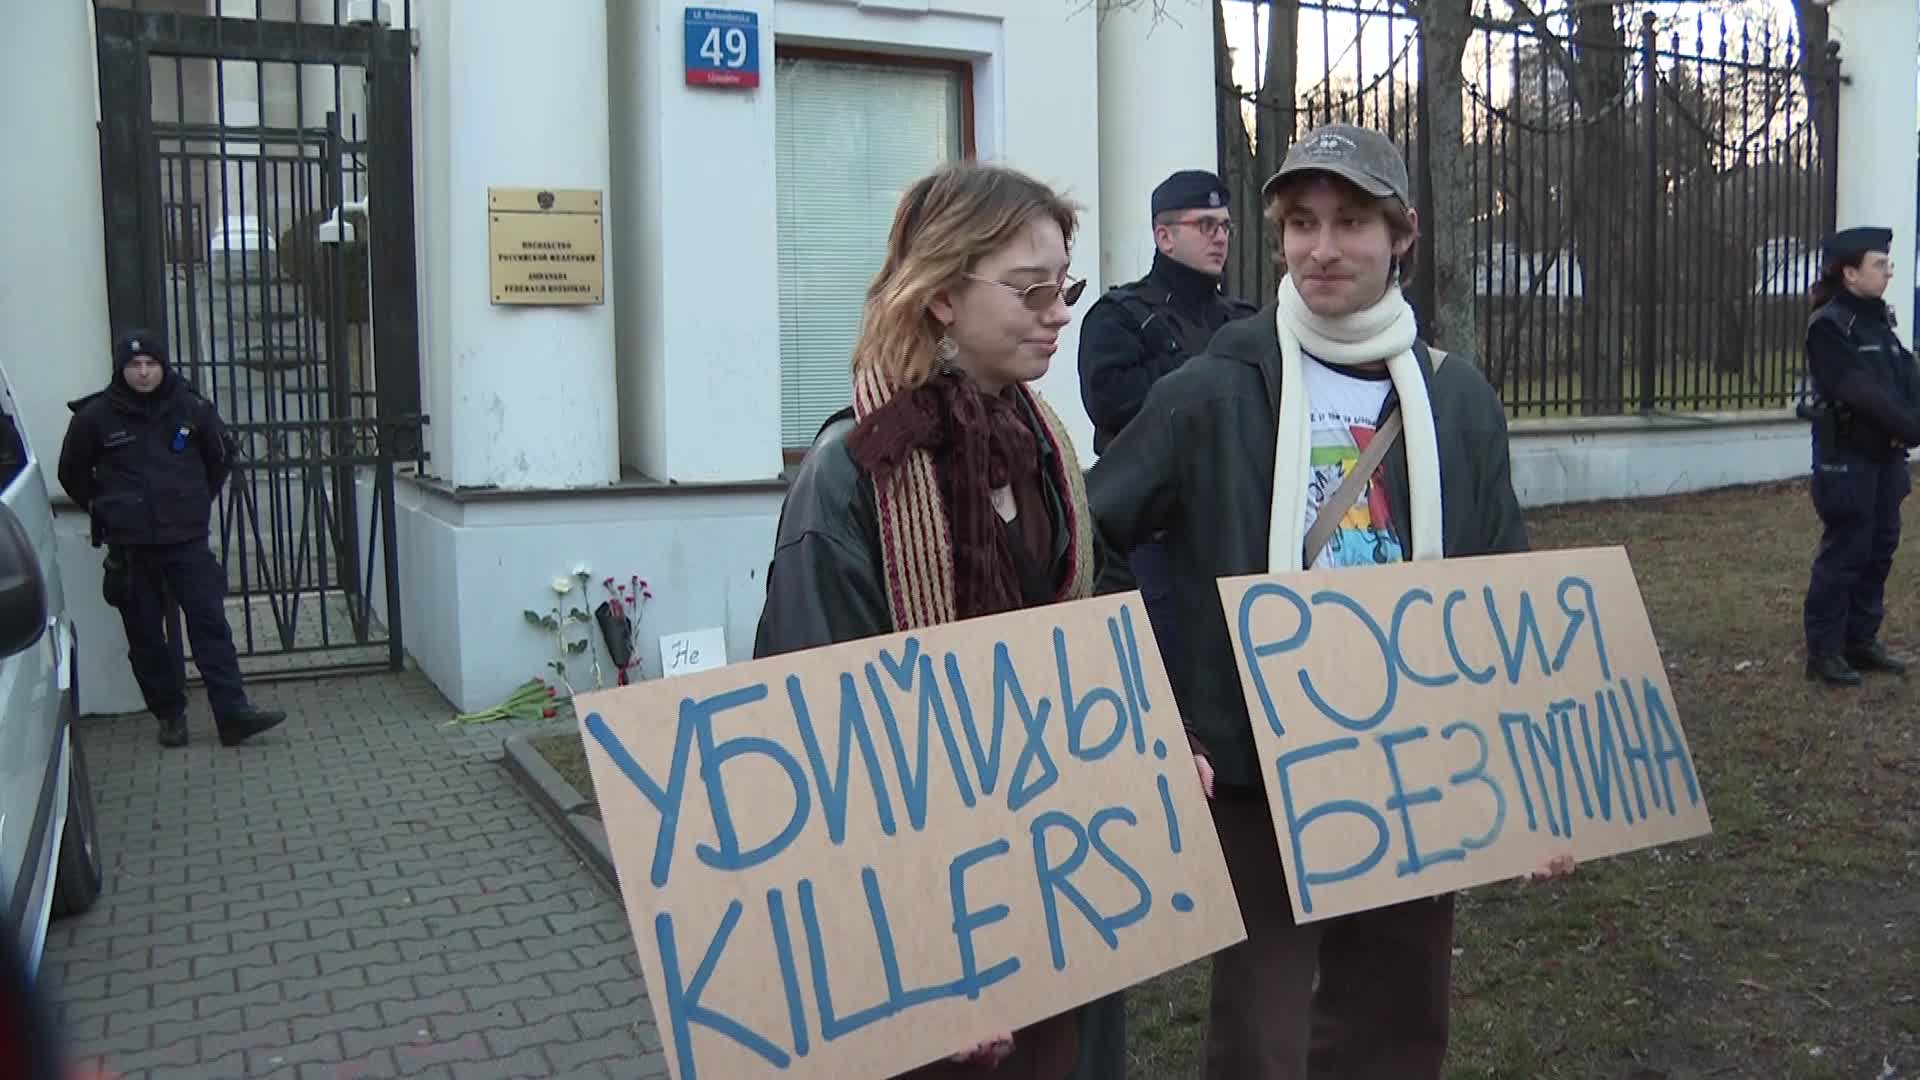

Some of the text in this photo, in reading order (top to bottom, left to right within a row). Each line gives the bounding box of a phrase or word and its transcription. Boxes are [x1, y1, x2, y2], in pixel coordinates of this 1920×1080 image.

[700, 27, 747, 69] 49
[1238, 576, 1612, 737] РОССИЯ
[1276, 677, 1700, 914] БЕЗ ПУТИНА
[654, 773, 1195, 1080] KILLERS!
